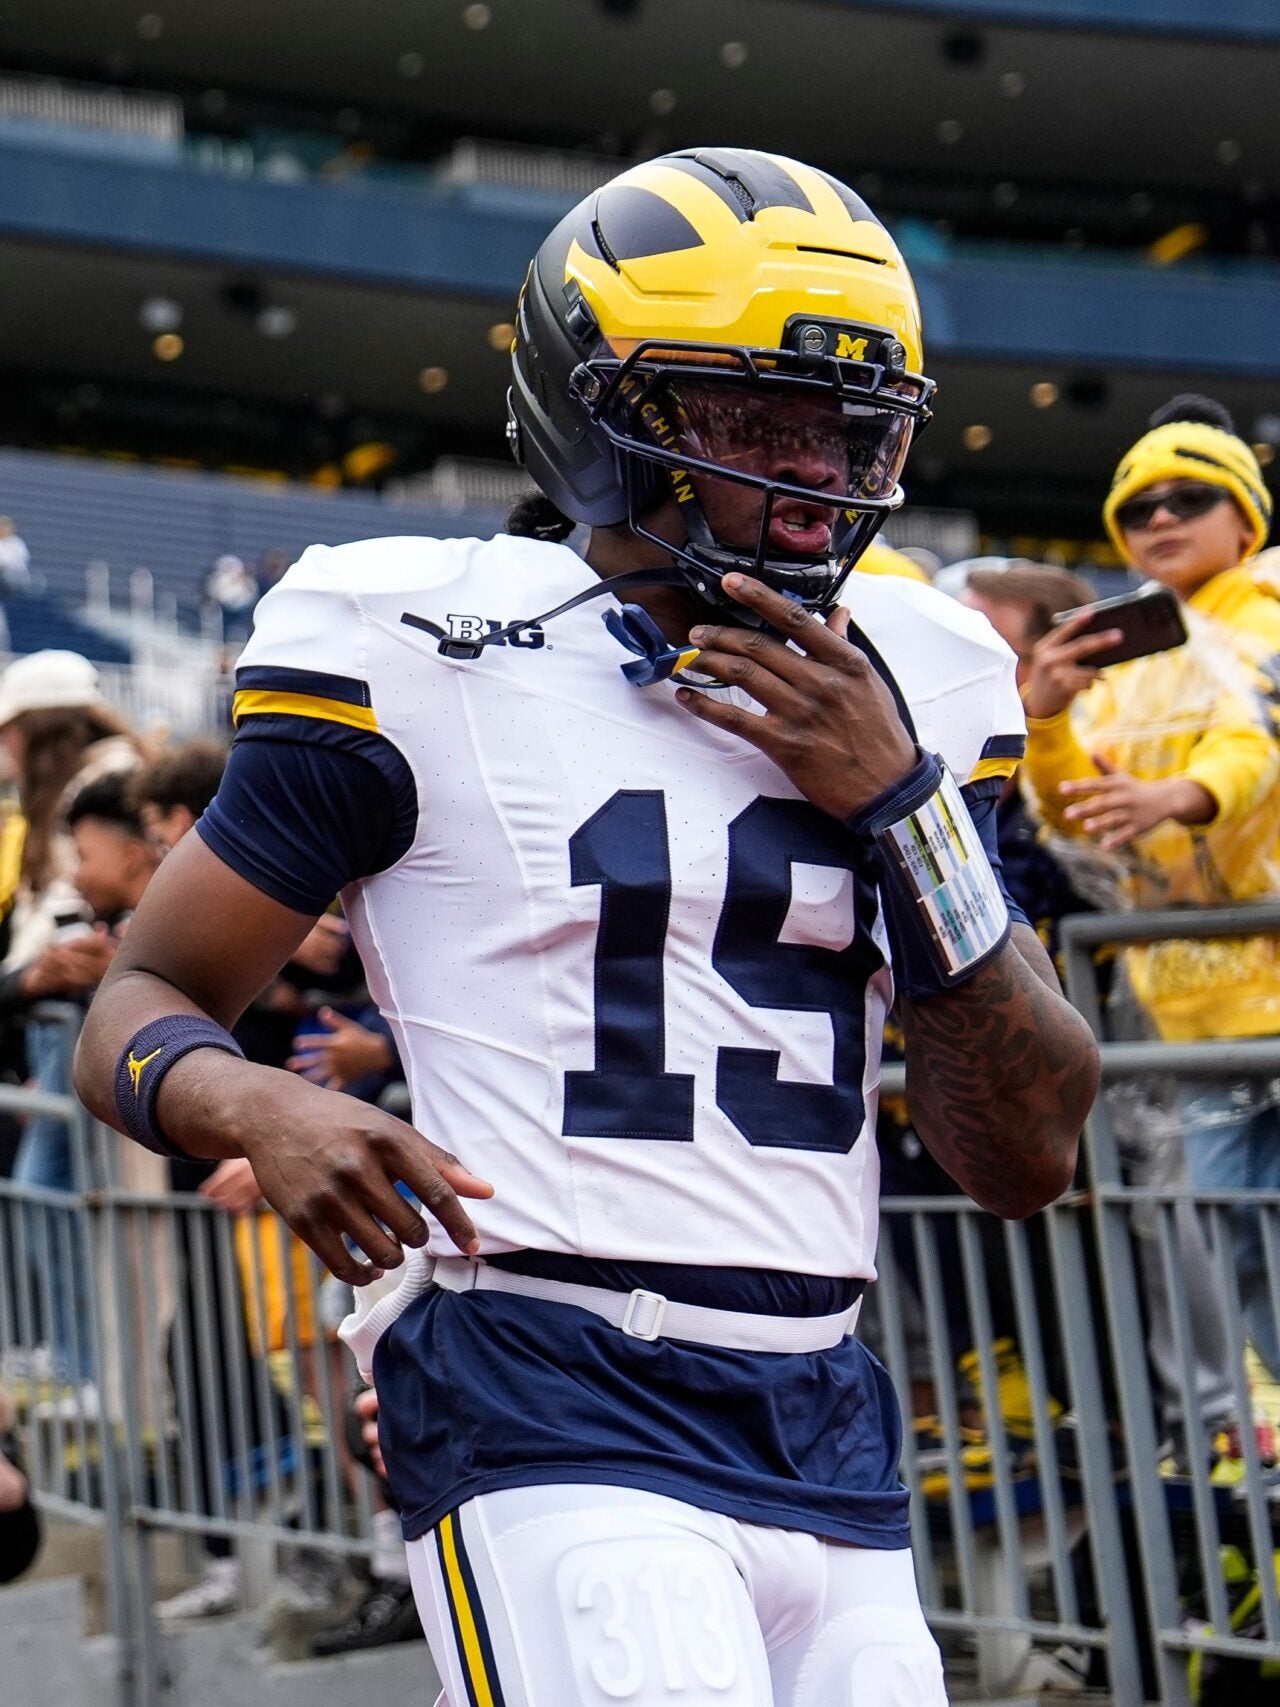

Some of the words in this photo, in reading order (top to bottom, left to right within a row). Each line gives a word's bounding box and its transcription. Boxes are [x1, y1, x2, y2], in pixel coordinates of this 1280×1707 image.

[835, 333, 869, 362] M
[561, 788, 885, 1156] 19
[576, 1559, 738, 1699] 313
